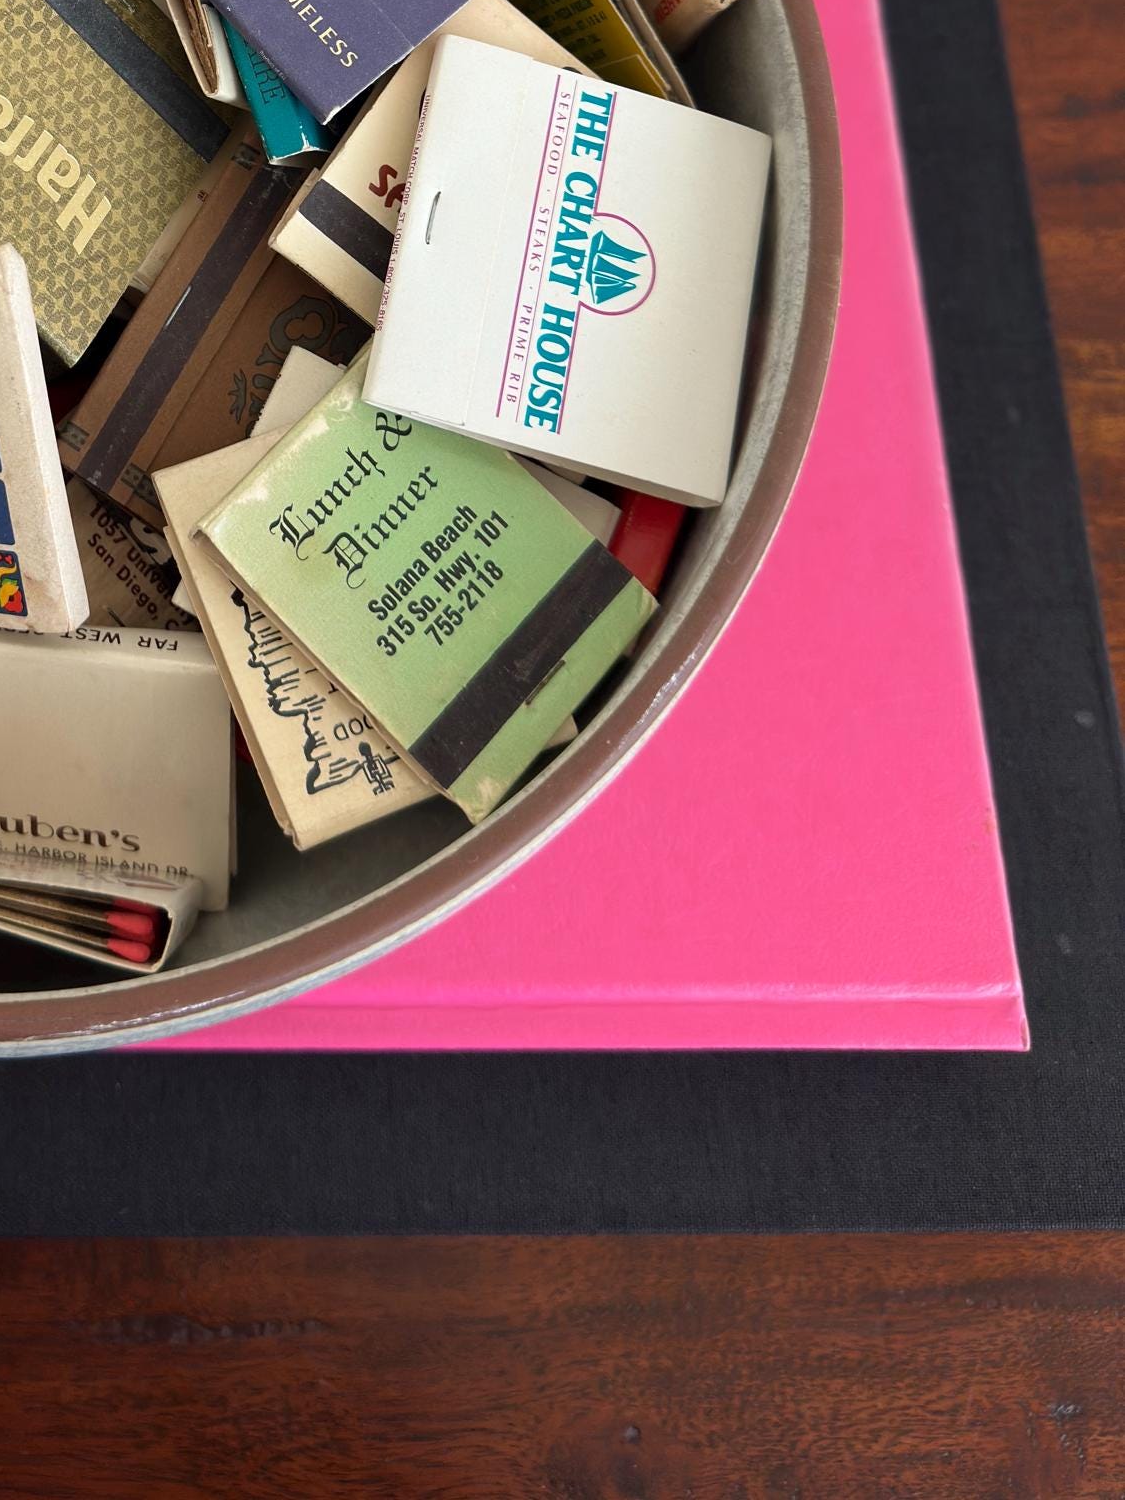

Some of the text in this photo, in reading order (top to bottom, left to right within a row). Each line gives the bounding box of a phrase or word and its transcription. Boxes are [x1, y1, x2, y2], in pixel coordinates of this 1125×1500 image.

[416, 94, 432, 144] UNIVERSAL
[571, 90, 614, 162] THE
[408, 146, 420, 180] MATCH
[506, 90, 572, 404] SEAFOOD STEAKS PRIME RIB
[547, 170, 598, 296] CHART
[523, 302, 577, 434] HOUSE
[89, 501, 126, 543] 1057
[269, 411, 413, 562] Lunch &
[322, 466, 439, 590] Dinner
[88, 534, 160, 621] San Diego,
[367, 504, 479, 622] Solana Beach
[376, 510, 509, 657] 315 So. Hwy. 101
[423, 559, 505, 647] 755-2118
[60, 626, 122, 645] WEST
[138, 635, 179, 652] FAR
[15, 841, 87, 863] HARBOR
[94, 855, 160, 875] ISLAND
